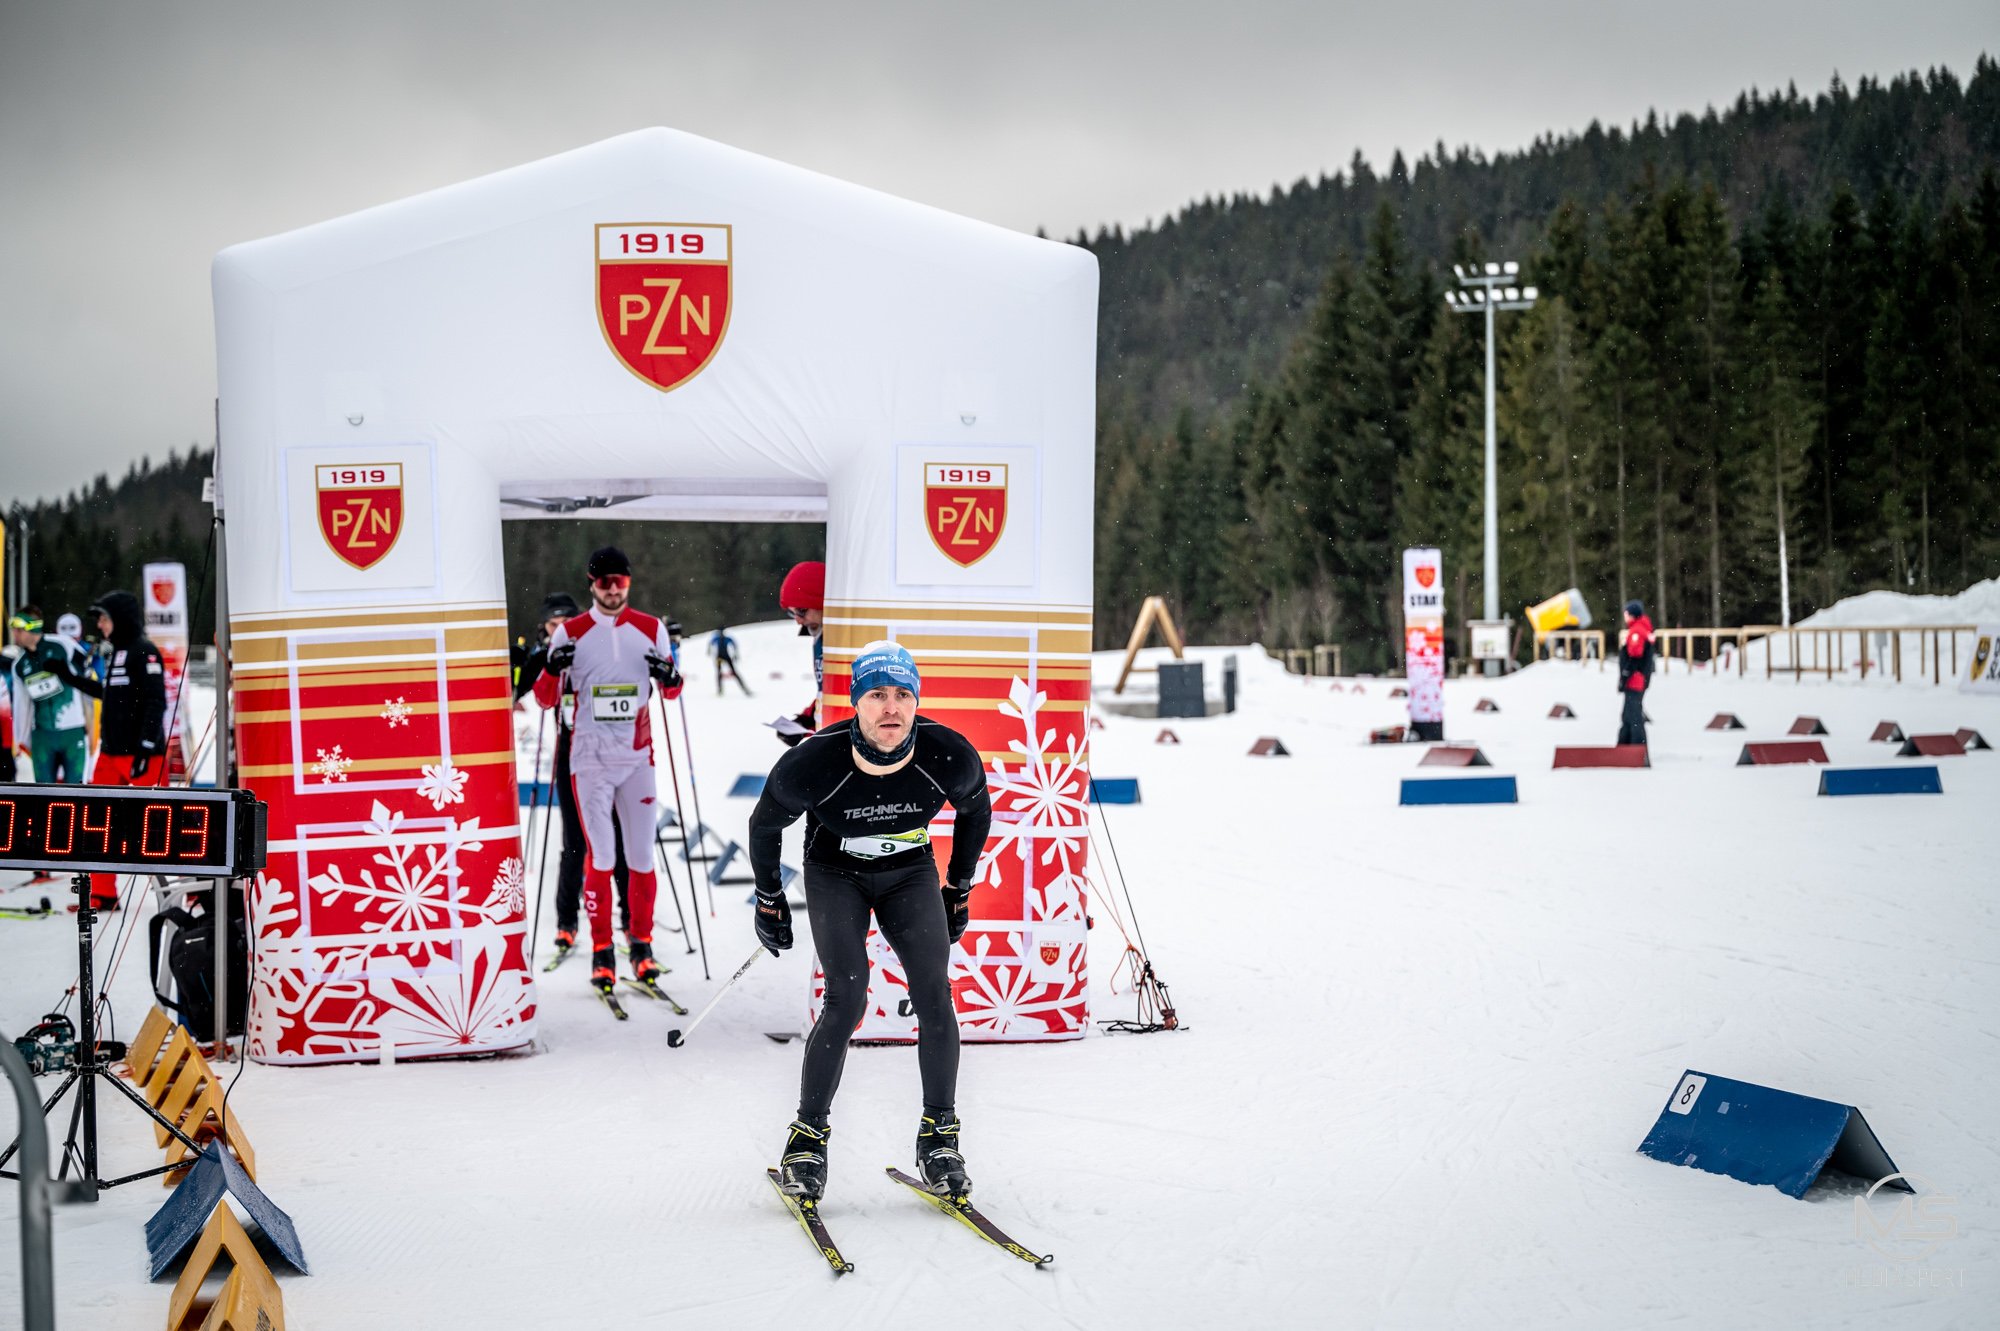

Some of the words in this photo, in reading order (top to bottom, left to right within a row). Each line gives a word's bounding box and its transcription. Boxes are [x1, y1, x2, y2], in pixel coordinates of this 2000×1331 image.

[619, 233, 704, 254] 1919
[619, 278, 710, 355] PZN
[331, 470, 385, 484] 1919
[939, 469, 991, 482] 1919
[332, 498, 391, 548] PZN
[938, 497, 994, 545] PZN
[610, 700, 629, 712] 10
[844, 803, 922, 819] TECHNICAL
[880, 842, 896, 853] 9
[1042, 949, 1058, 961] PZN
[1681, 1084, 1696, 1105] 8
